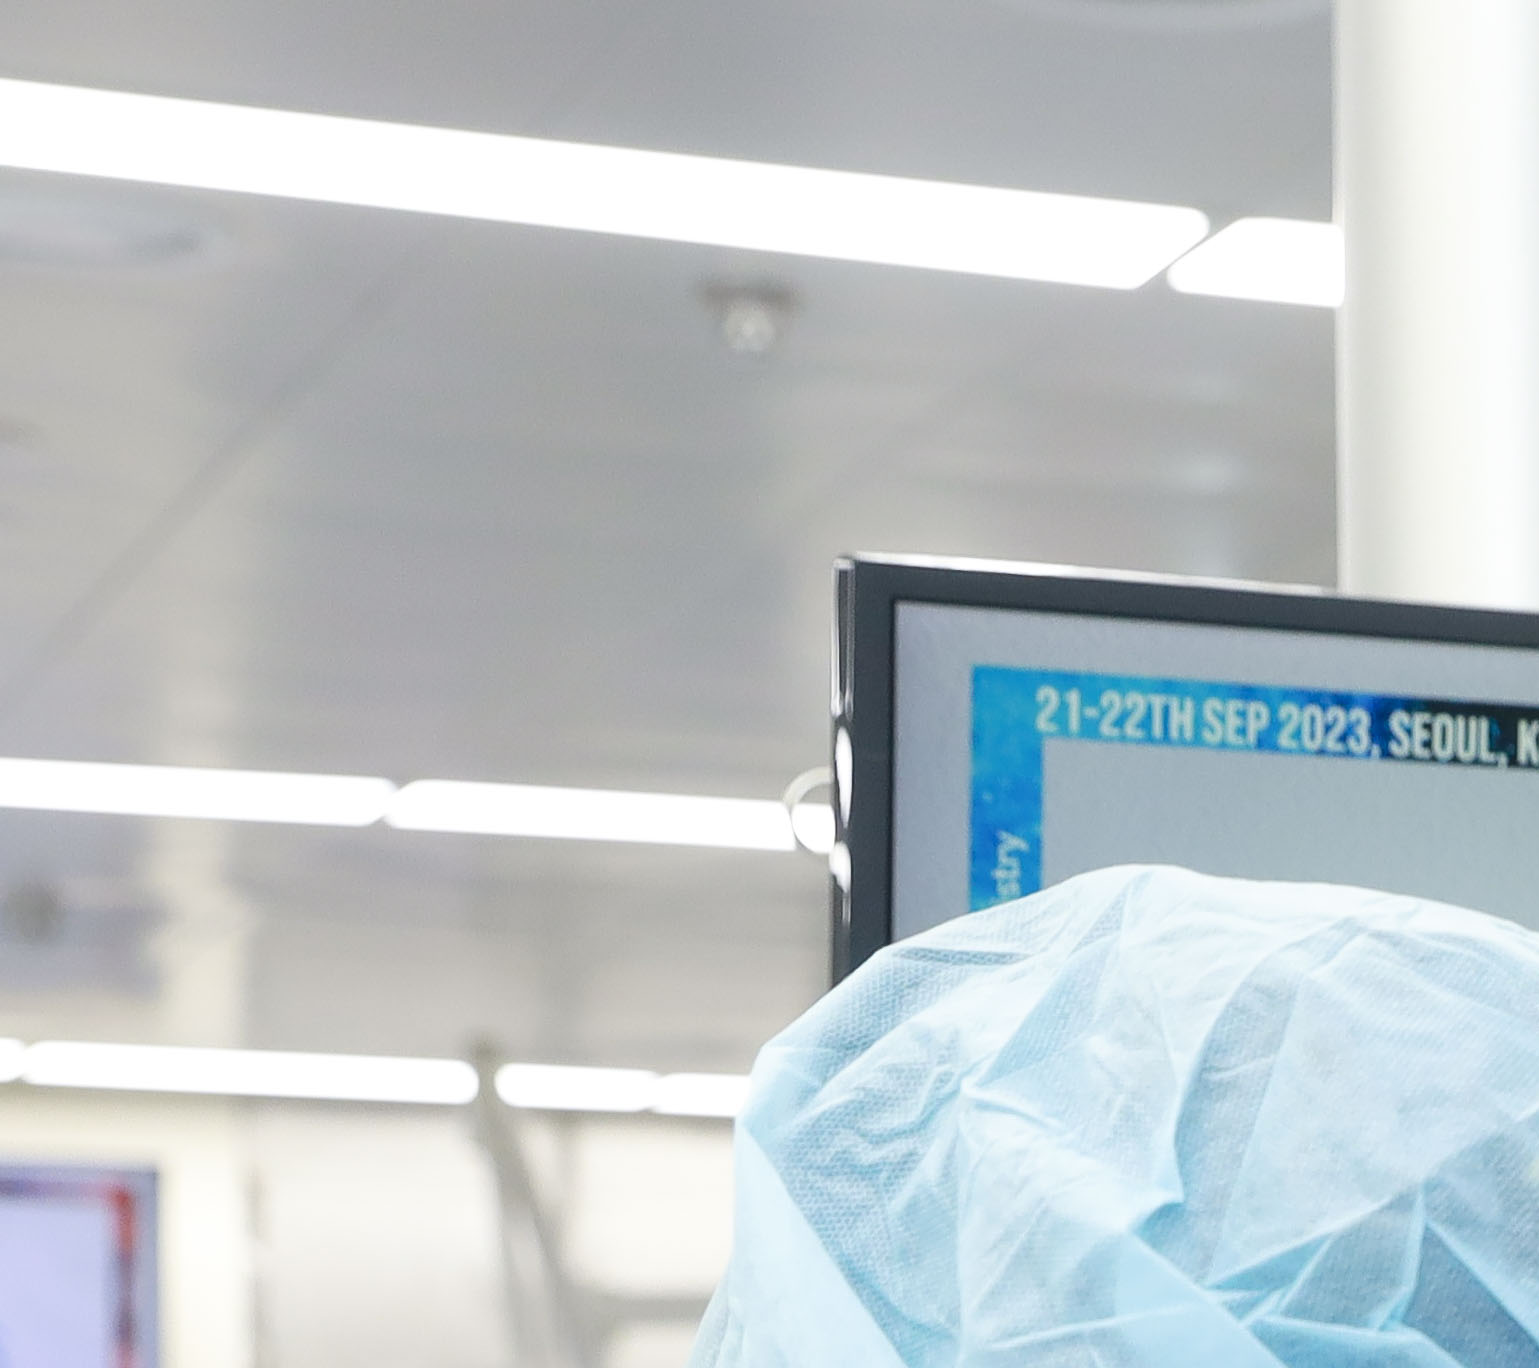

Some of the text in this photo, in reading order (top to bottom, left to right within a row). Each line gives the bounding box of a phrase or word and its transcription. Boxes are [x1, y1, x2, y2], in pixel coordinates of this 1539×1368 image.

[1035, 687, 1193, 744] 21-22TH
[1202, 696, 1271, 747] SEP
[1277, 702, 1381, 759] 2023,
[1388, 711, 1507, 768] SEOUL,
